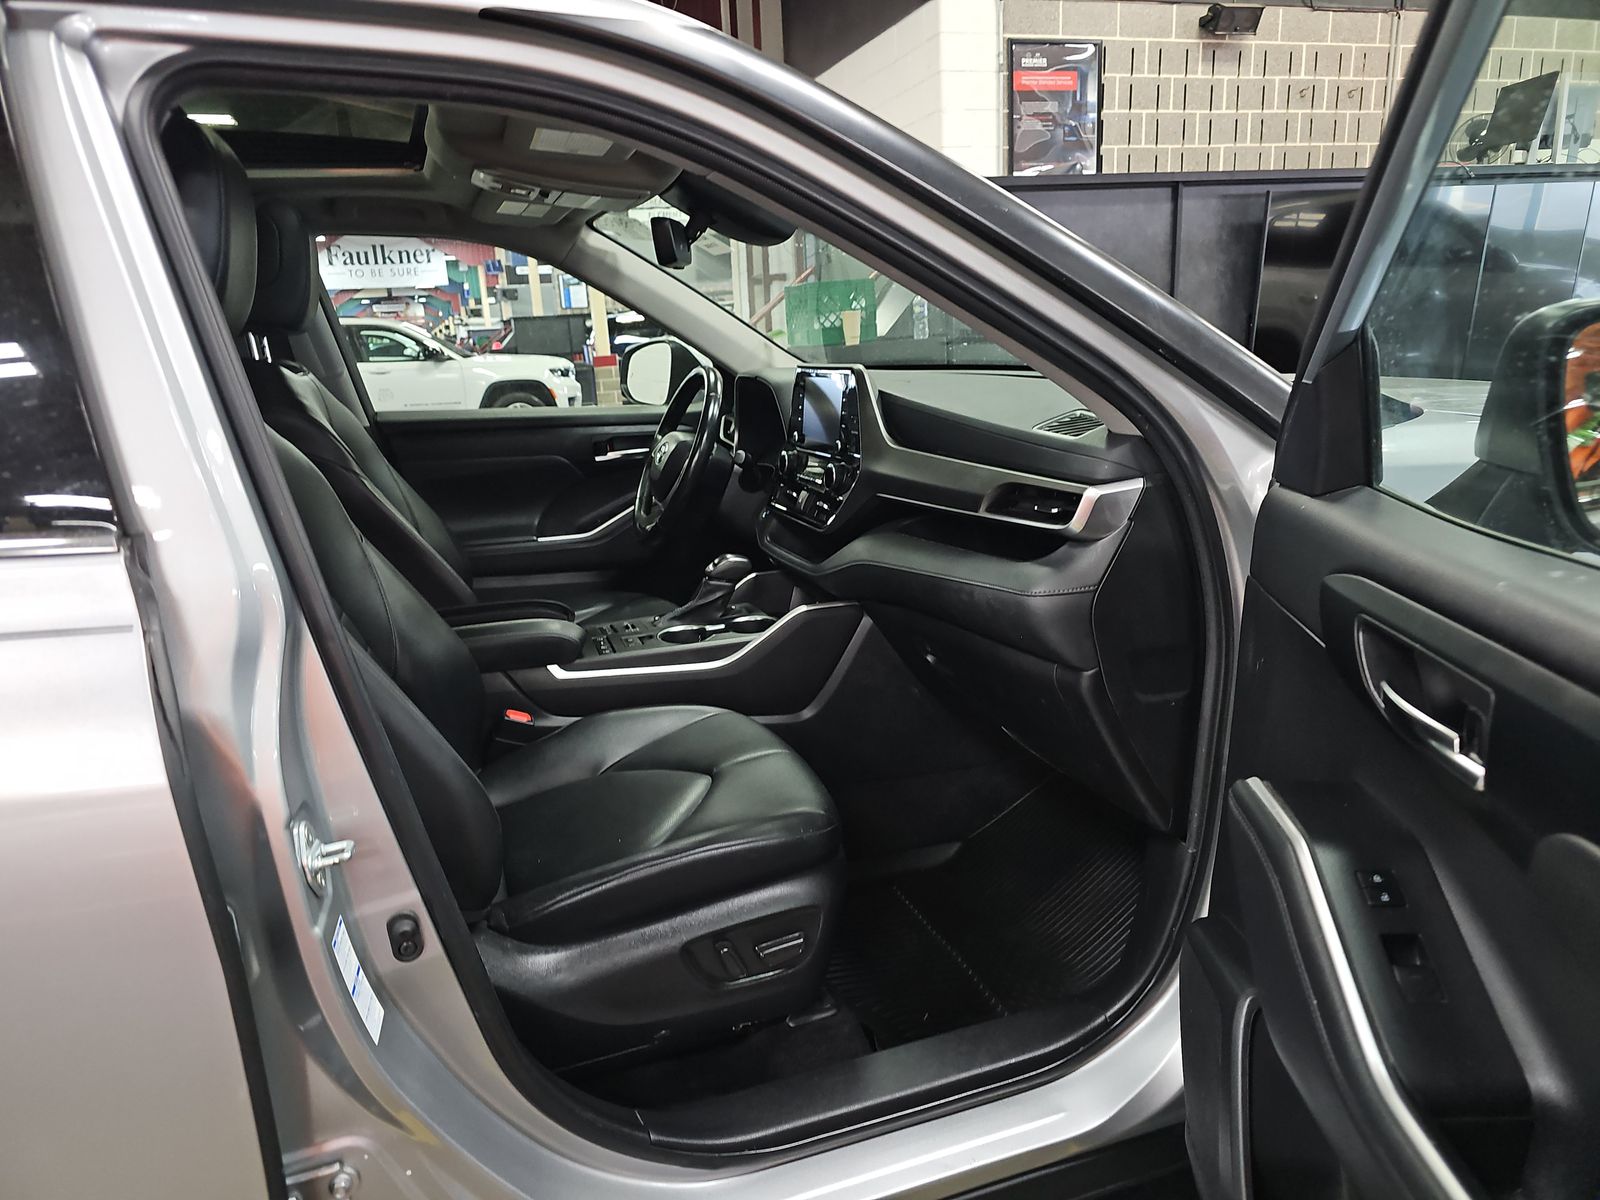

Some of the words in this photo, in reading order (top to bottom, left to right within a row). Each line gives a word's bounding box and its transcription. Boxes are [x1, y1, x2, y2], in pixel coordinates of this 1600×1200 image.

[326, 244, 435, 266] Faulkner
[348, 269, 365, 278] TO
[370, 268, 385, 278] BE
[390, 267, 419, 277] SURE
